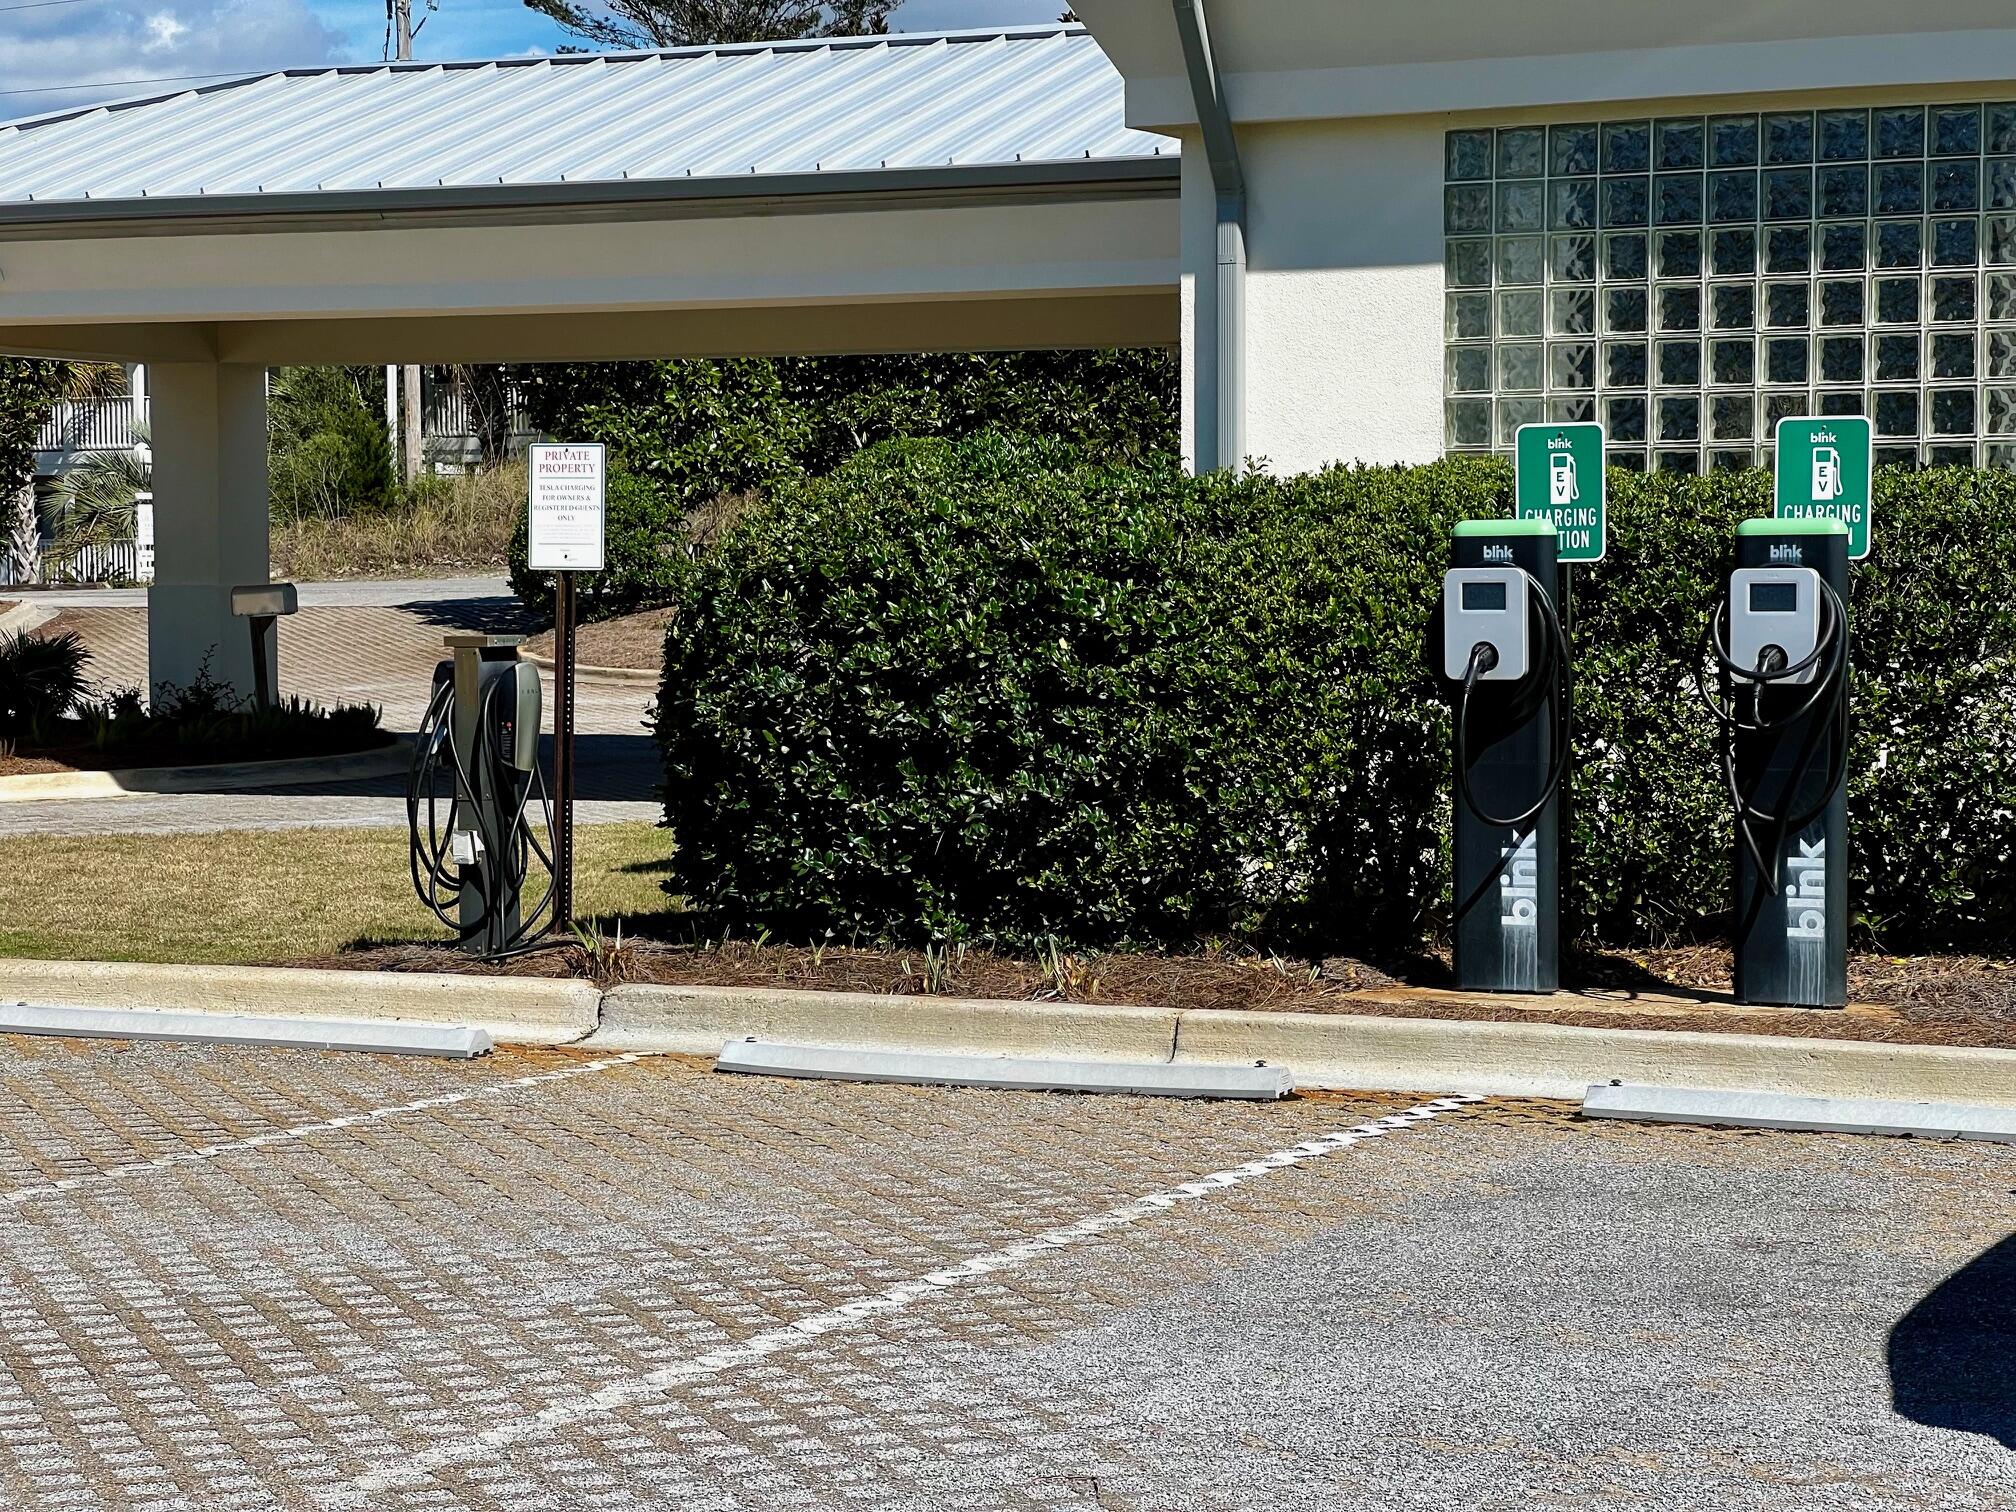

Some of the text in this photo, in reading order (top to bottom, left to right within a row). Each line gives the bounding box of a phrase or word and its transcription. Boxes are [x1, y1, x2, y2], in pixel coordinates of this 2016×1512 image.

[1547, 437, 1573, 449] blink
[1810, 431, 1837, 443] blink
[545, 450, 590, 461] PRIVATE
[539, 463, 595, 473] PROPERTY
[1784, 504, 1861, 523] CHARGING
[1557, 530, 1590, 550] TION
[1483, 544, 1514, 559] blink
[1769, 544, 1803, 559] blink
[1785, 837, 1826, 937] blink
